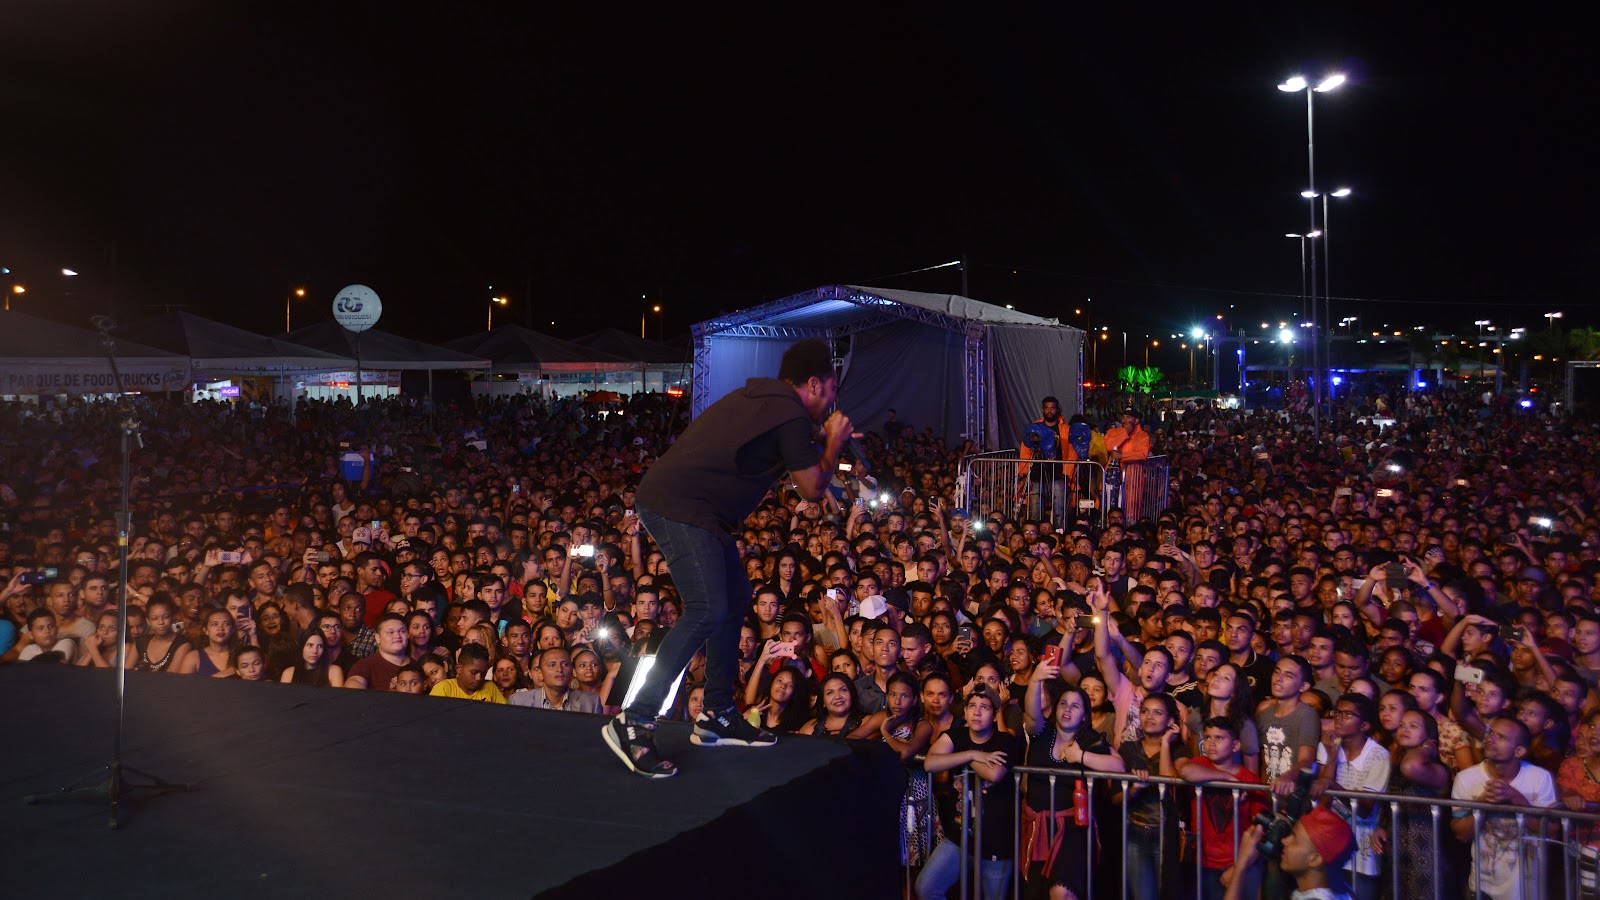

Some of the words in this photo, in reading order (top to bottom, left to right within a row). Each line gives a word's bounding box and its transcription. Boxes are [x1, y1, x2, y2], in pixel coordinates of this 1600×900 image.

[9, 373, 60, 387] PARQUE
[64, 373, 80, 387] DE
[84, 373, 114, 386] FOOD
